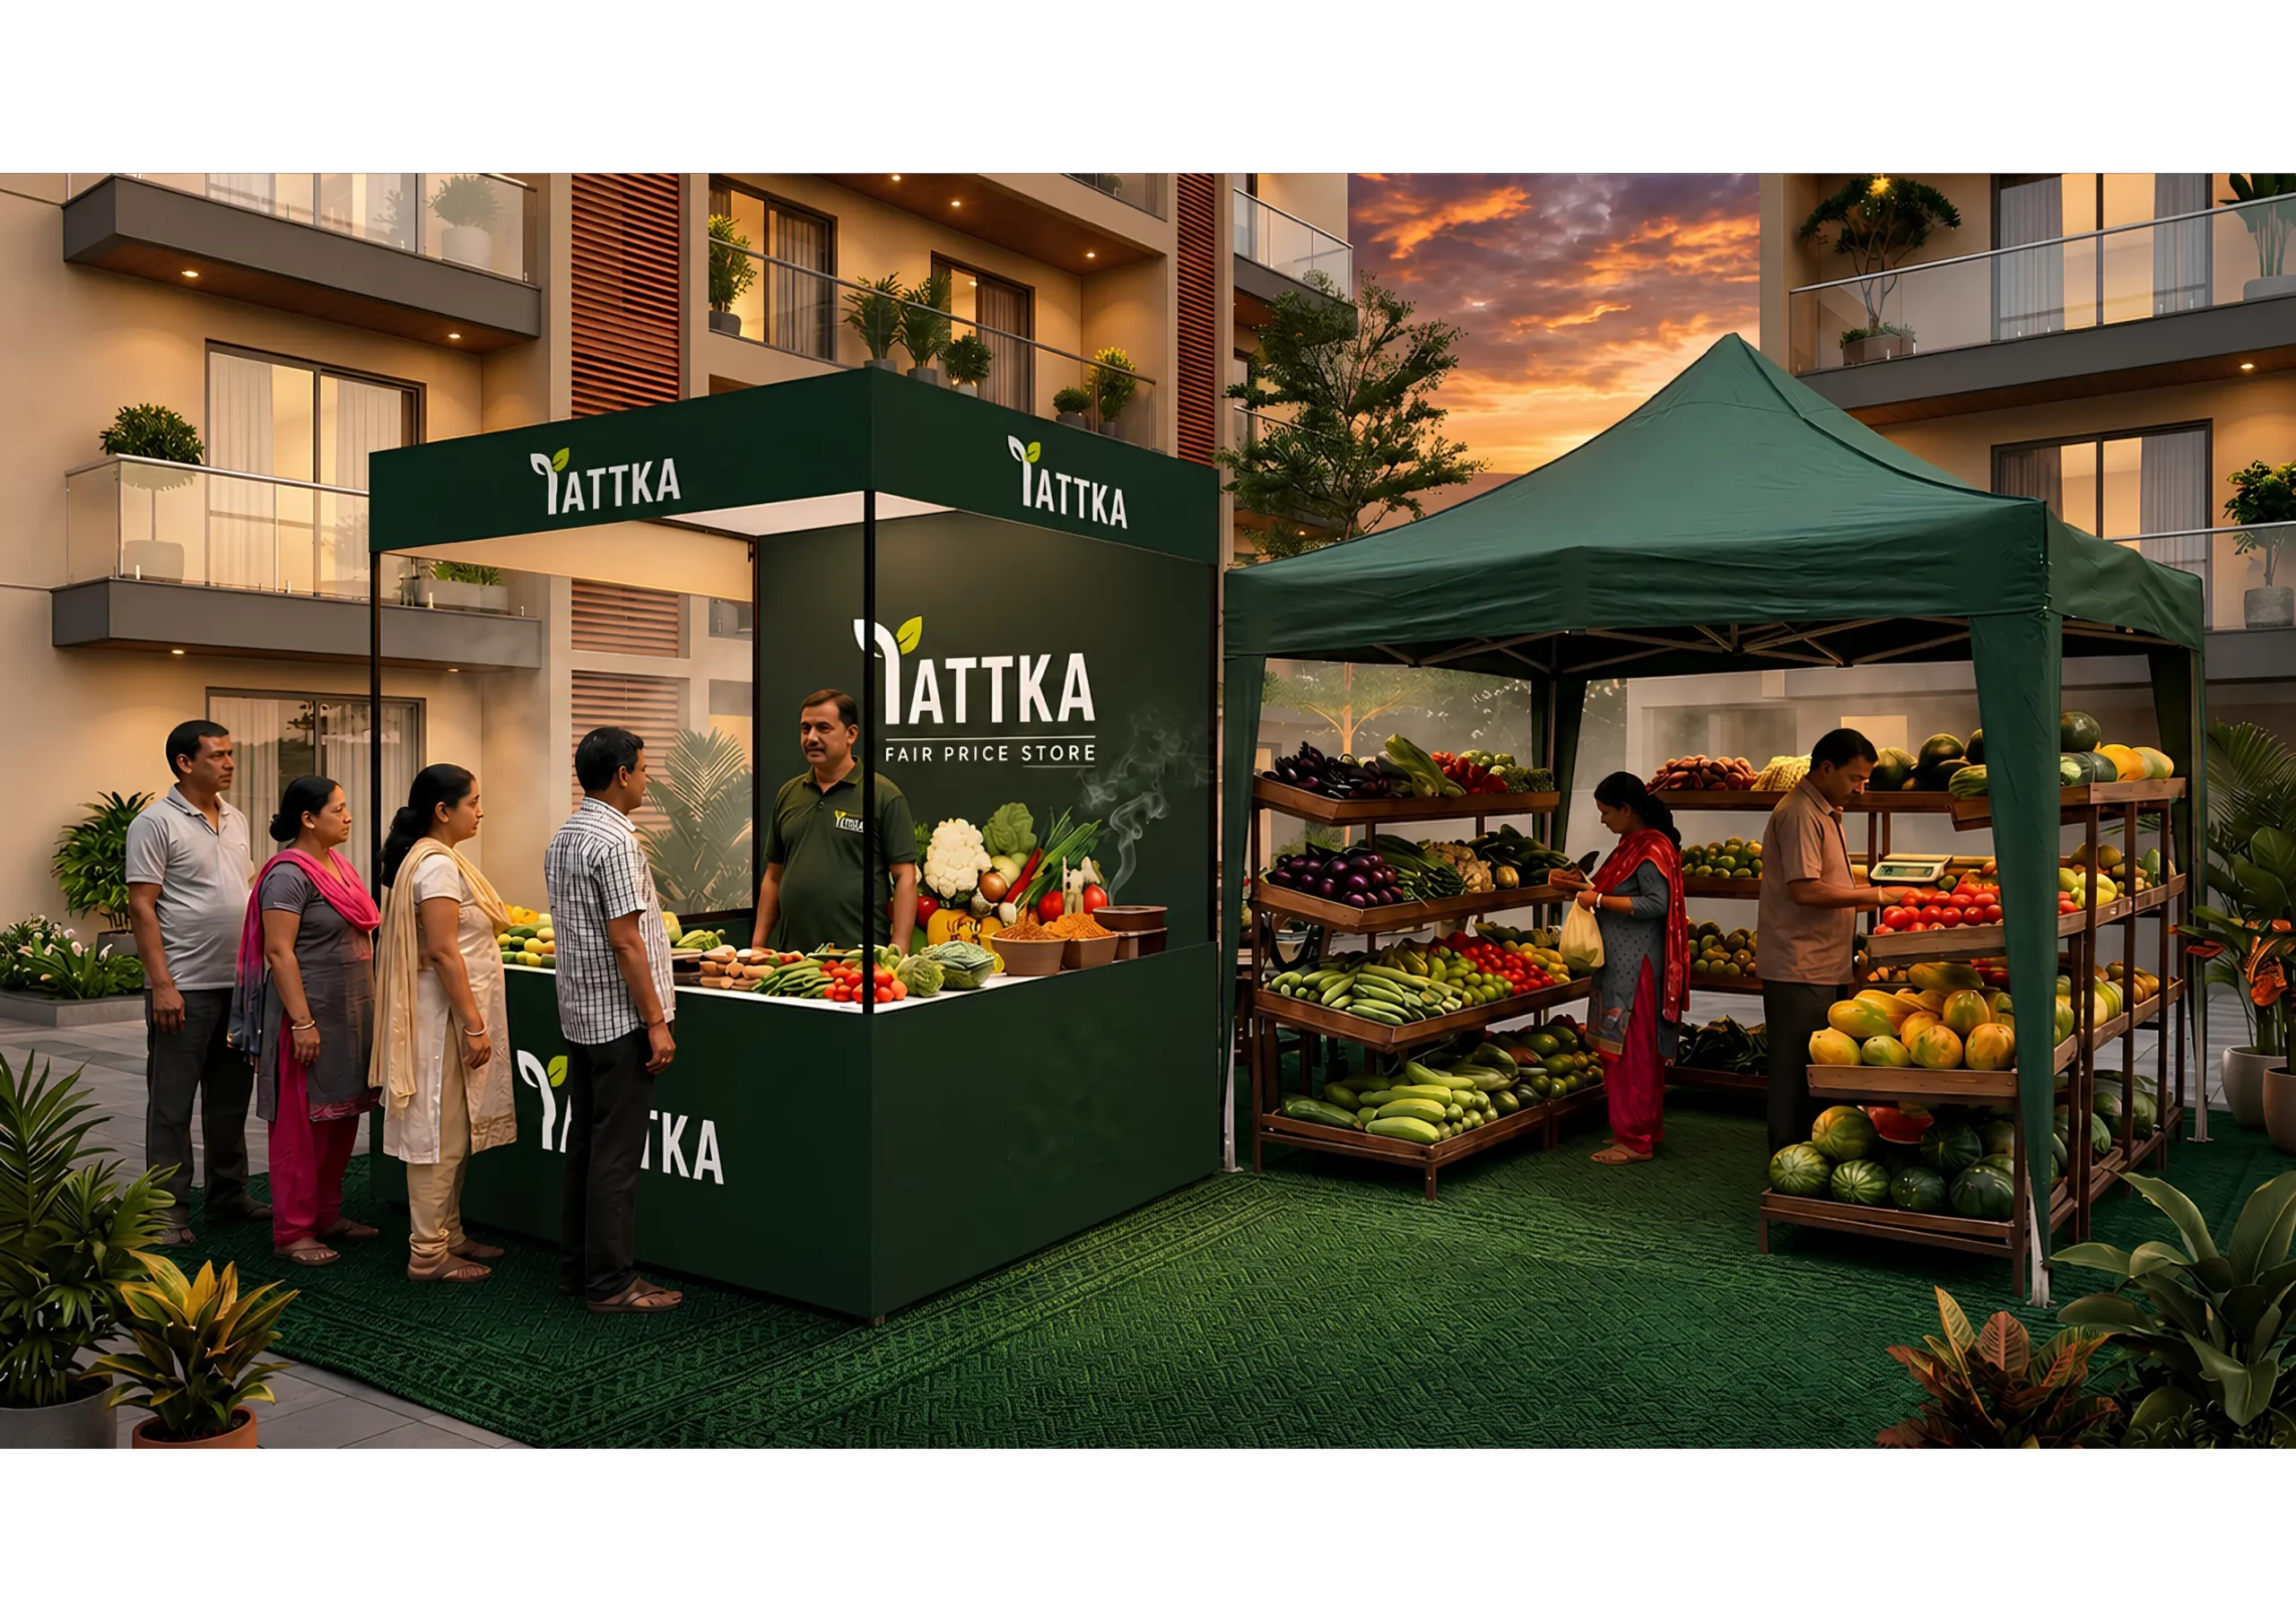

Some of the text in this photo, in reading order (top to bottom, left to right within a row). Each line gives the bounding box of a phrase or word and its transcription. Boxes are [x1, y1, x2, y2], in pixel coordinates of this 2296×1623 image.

[885, 744, 1095, 762] FAIR PRICE STORE
